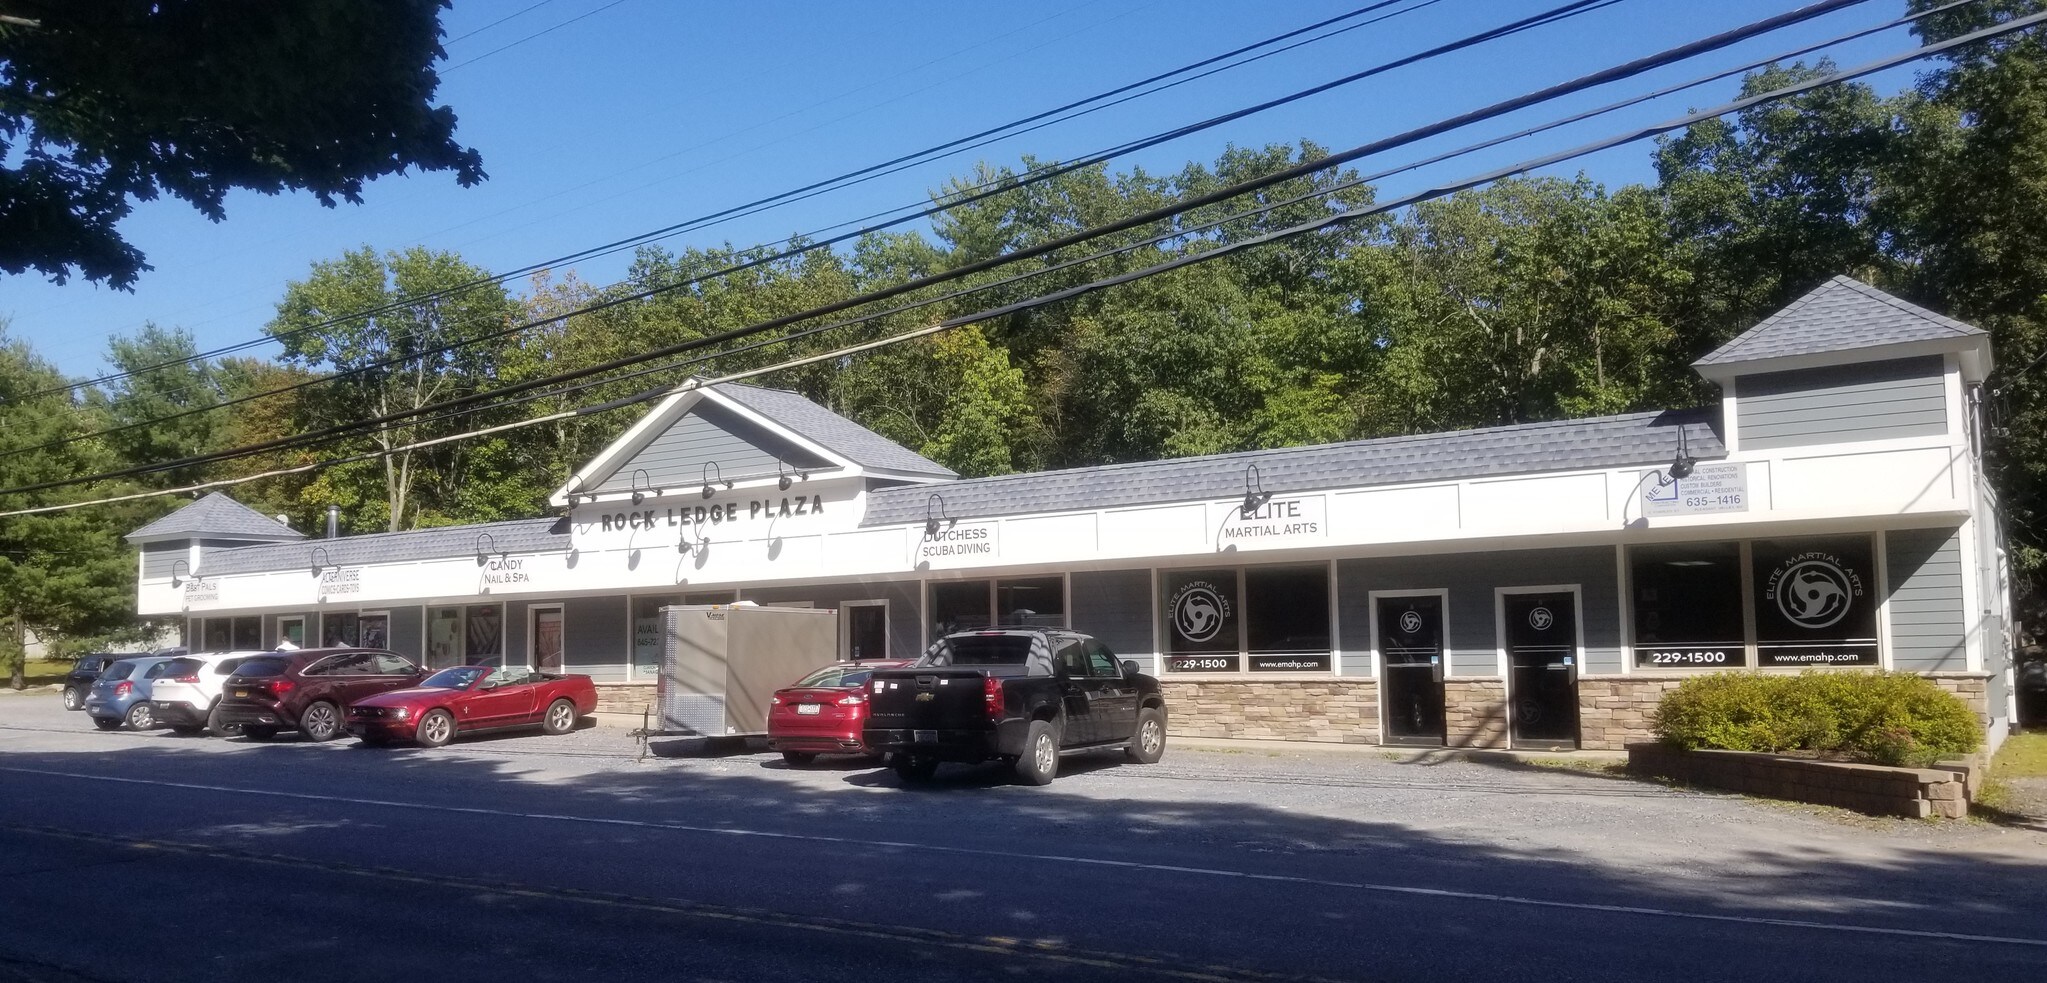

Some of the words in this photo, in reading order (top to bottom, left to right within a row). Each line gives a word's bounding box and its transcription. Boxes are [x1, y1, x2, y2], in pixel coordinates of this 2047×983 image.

[1702, 466, 1738, 474] CONSTRUCTION
[1680, 482, 1699, 490] CUSTOM
[1700, 480, 1722, 488] BUILDERS
[1680, 488, 1711, 496] COMMERCIAL
[1714, 486, 1744, 494] RESIDENTIAL
[1686, 494, 1741, 507] 635-1416
[601, 509, 656, 532] ROCK
[667, 503, 738, 527] LEDGE
[750, 495, 824, 520] PLAZA
[1239, 501, 1301, 521] ELITE
[924, 528, 988, 543] DUTCHESS
[1225, 525, 1281, 539] MARTIAL
[1283, 522, 1318, 535] ARTS
[923, 545, 955, 557] SCUBA
[957, 542, 991, 555] DIVING
[490, 559, 523, 571] CANDY
[484, 574, 504, 584] NAIL
[504, 572, 511, 583] &
[512, 572, 530, 583] SPA
[1766, 567, 1783, 600] ELITE
[1785, 552, 1841, 567] MARTIAL
[1845, 568, 1863, 597] ARTS
[201, 582, 217, 592] PALS
[1168, 592, 1181, 619] ELITE
[1181, 581, 1218, 593] MARTIAL
[1218, 594, 1231, 618] ARTS
[1652, 651, 1726, 663] 229-1500
[1774, 652, 1859, 664] www.emahp.com
[1176, 659, 1227, 669] 229-1500
[1259, 660, 1319, 669] www.emahp.com
